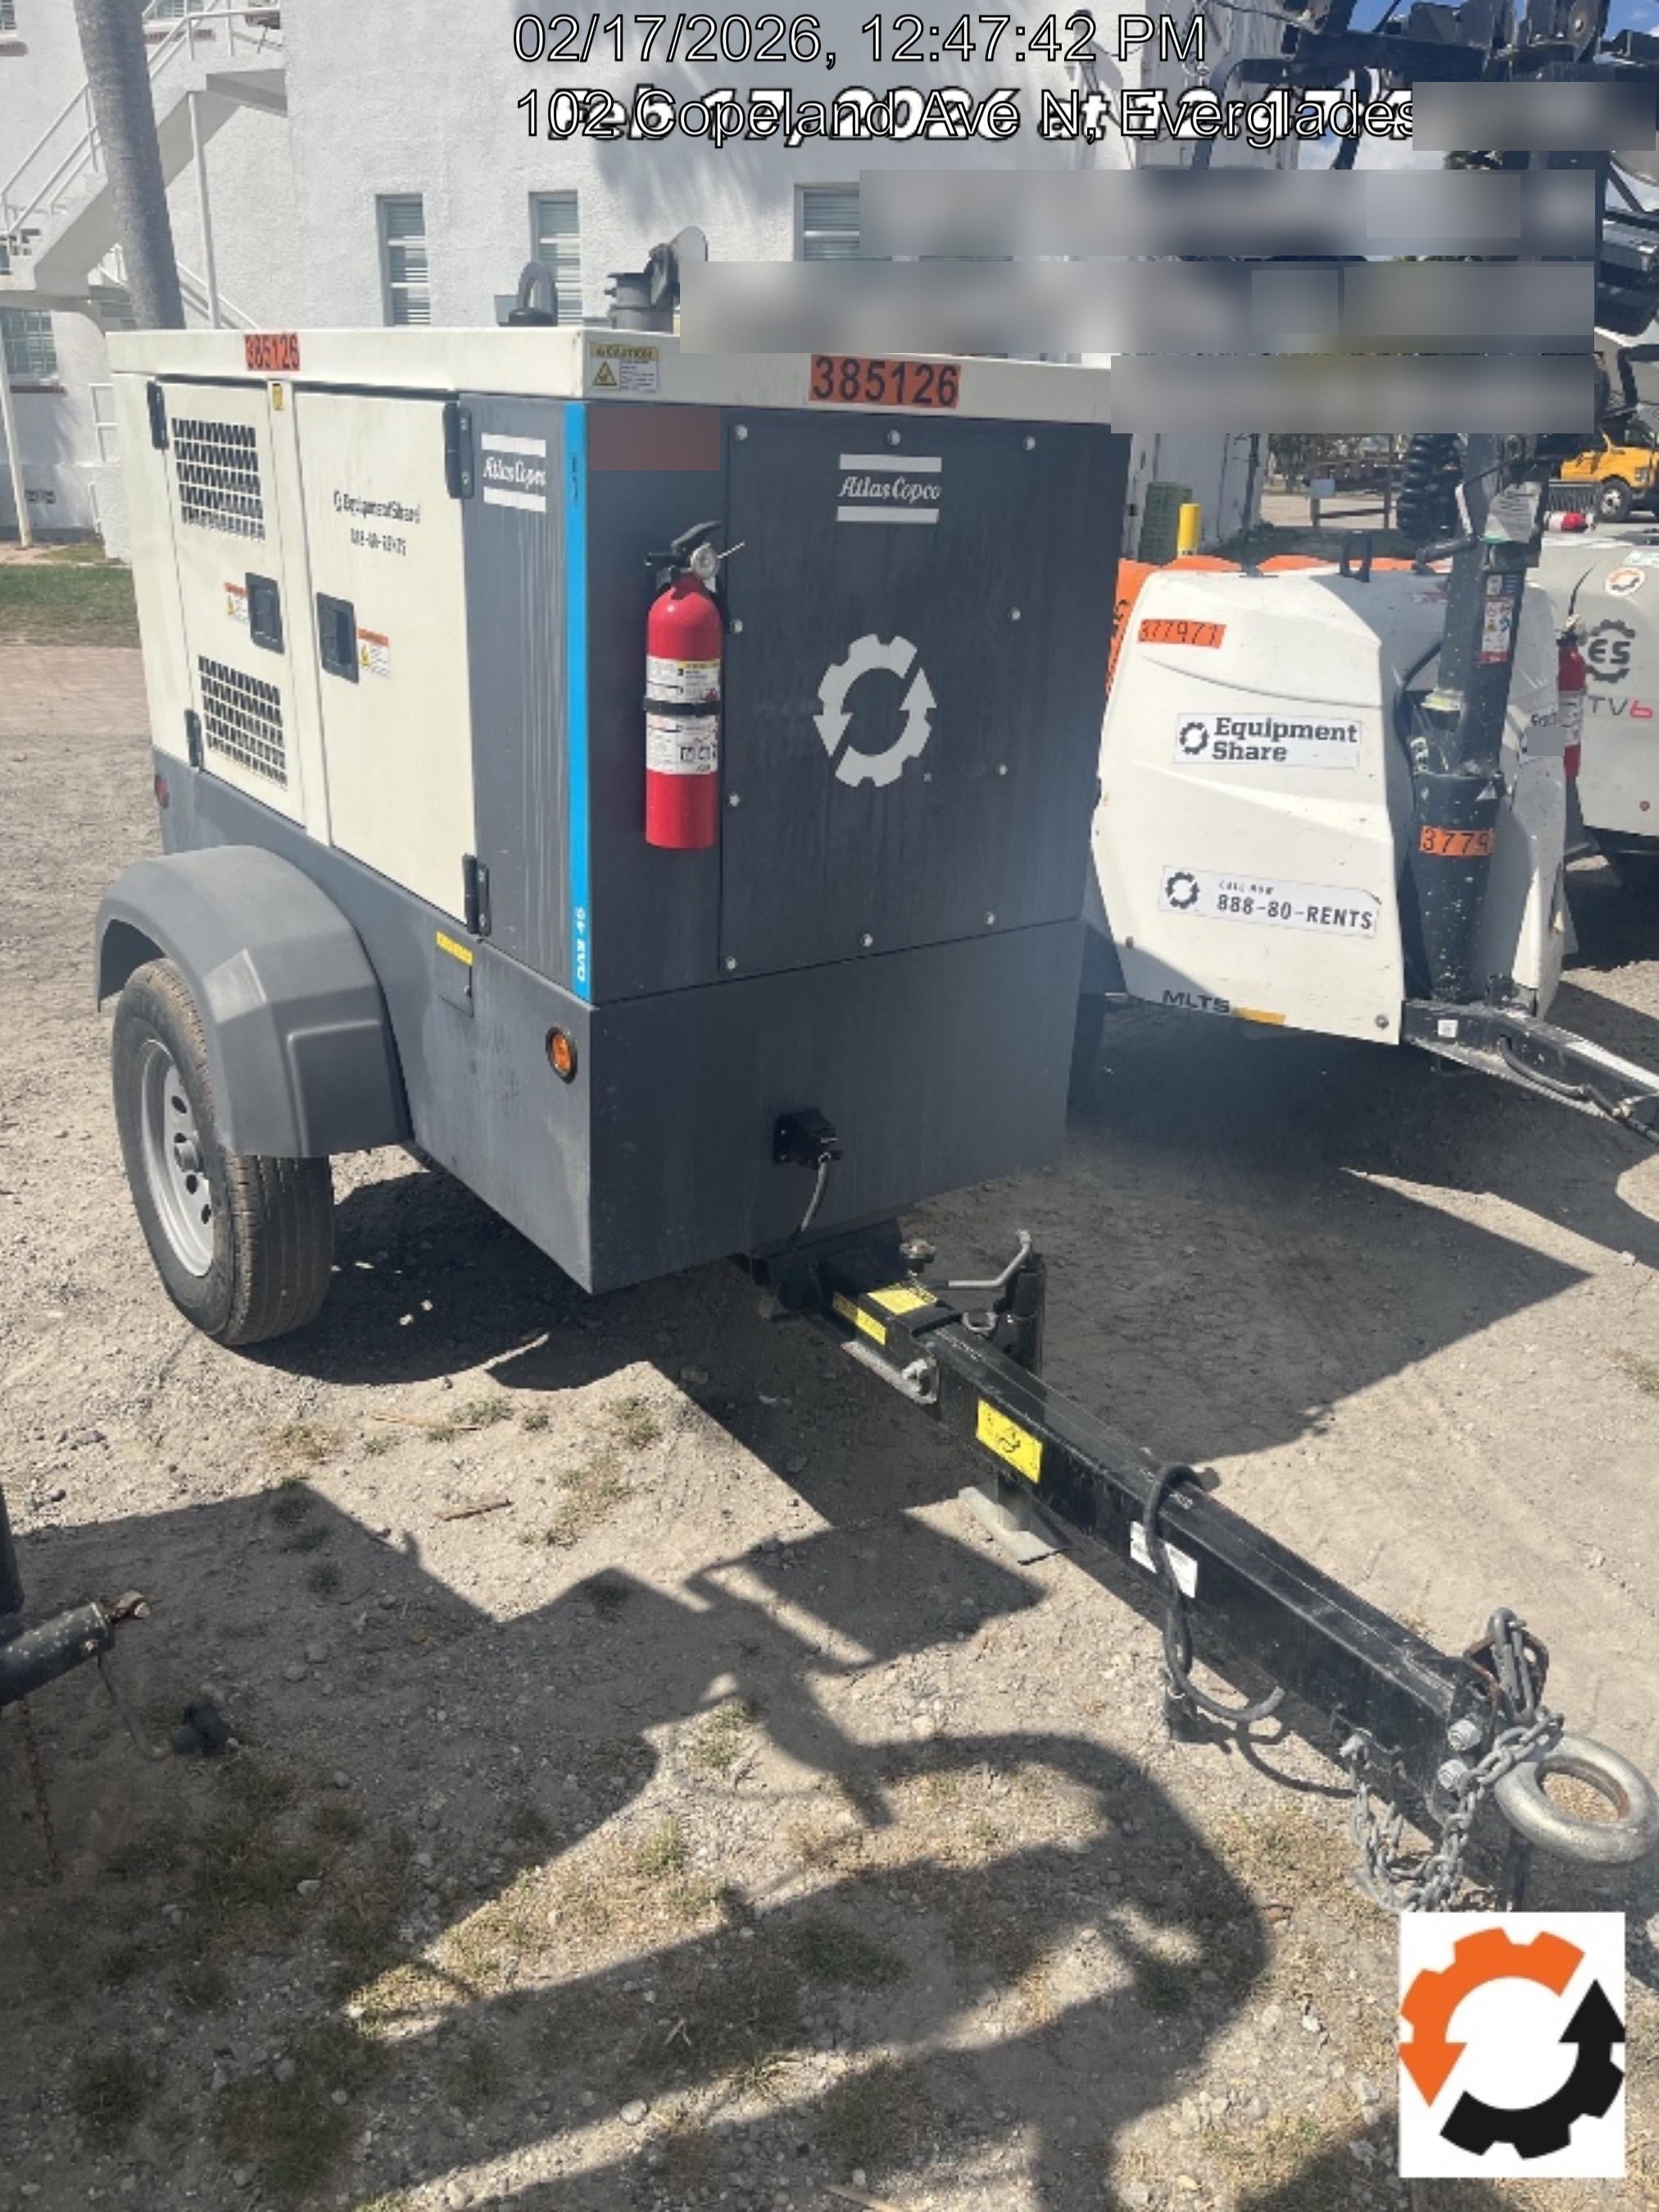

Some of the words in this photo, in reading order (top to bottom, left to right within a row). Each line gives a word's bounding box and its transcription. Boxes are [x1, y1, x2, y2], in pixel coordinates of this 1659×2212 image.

[813, 356, 957, 406] 385126
[1213, 717, 1358, 742] Equipment
[1212, 741, 1288, 762] Share
[1217, 893, 1373, 930] 888-80-RENTS
